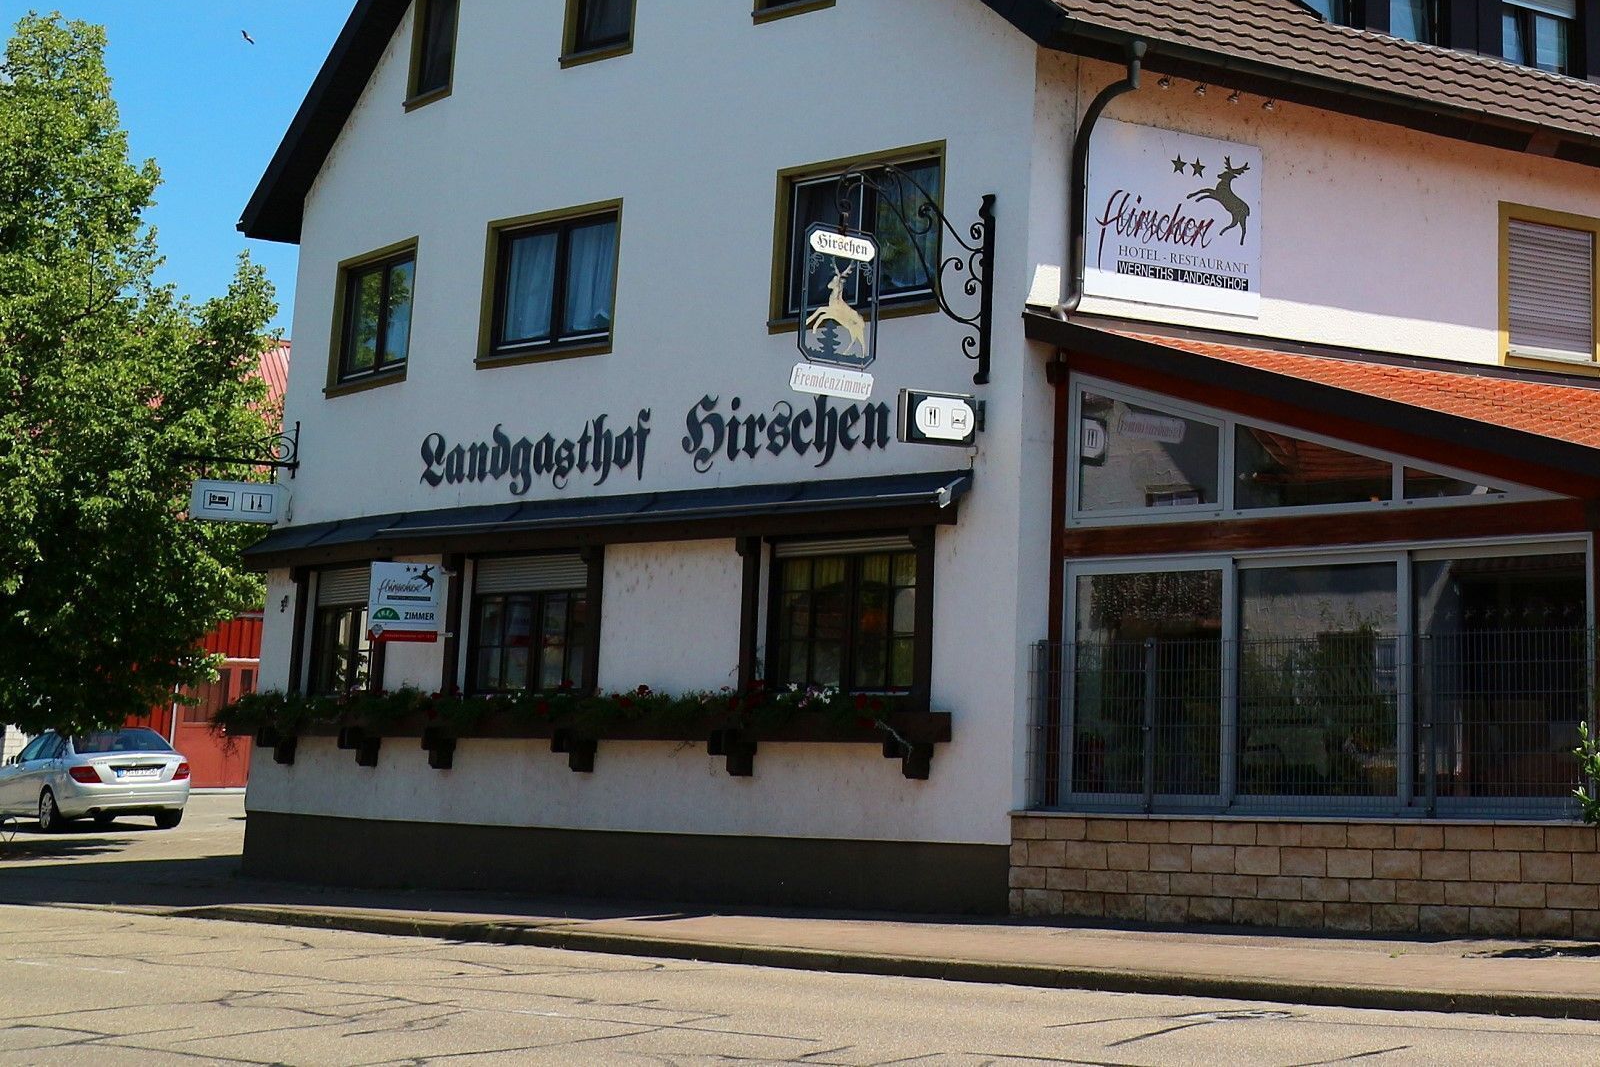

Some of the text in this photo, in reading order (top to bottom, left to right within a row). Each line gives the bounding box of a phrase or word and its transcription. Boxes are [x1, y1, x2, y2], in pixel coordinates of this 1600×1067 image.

[817, 234, 868, 255] Hirschen
[1118, 245, 1160, 262] HOTEL
[1170, 252, 1249, 274] RESTAURANT
[1119, 261, 1248, 291] WERNETHS LANDGASTHOF
[793, 368, 871, 395] Fremdenzimmer
[420, 393, 891, 495] Landgasthof Hirschen
[404, 612, 434, 620] ZIMMER
